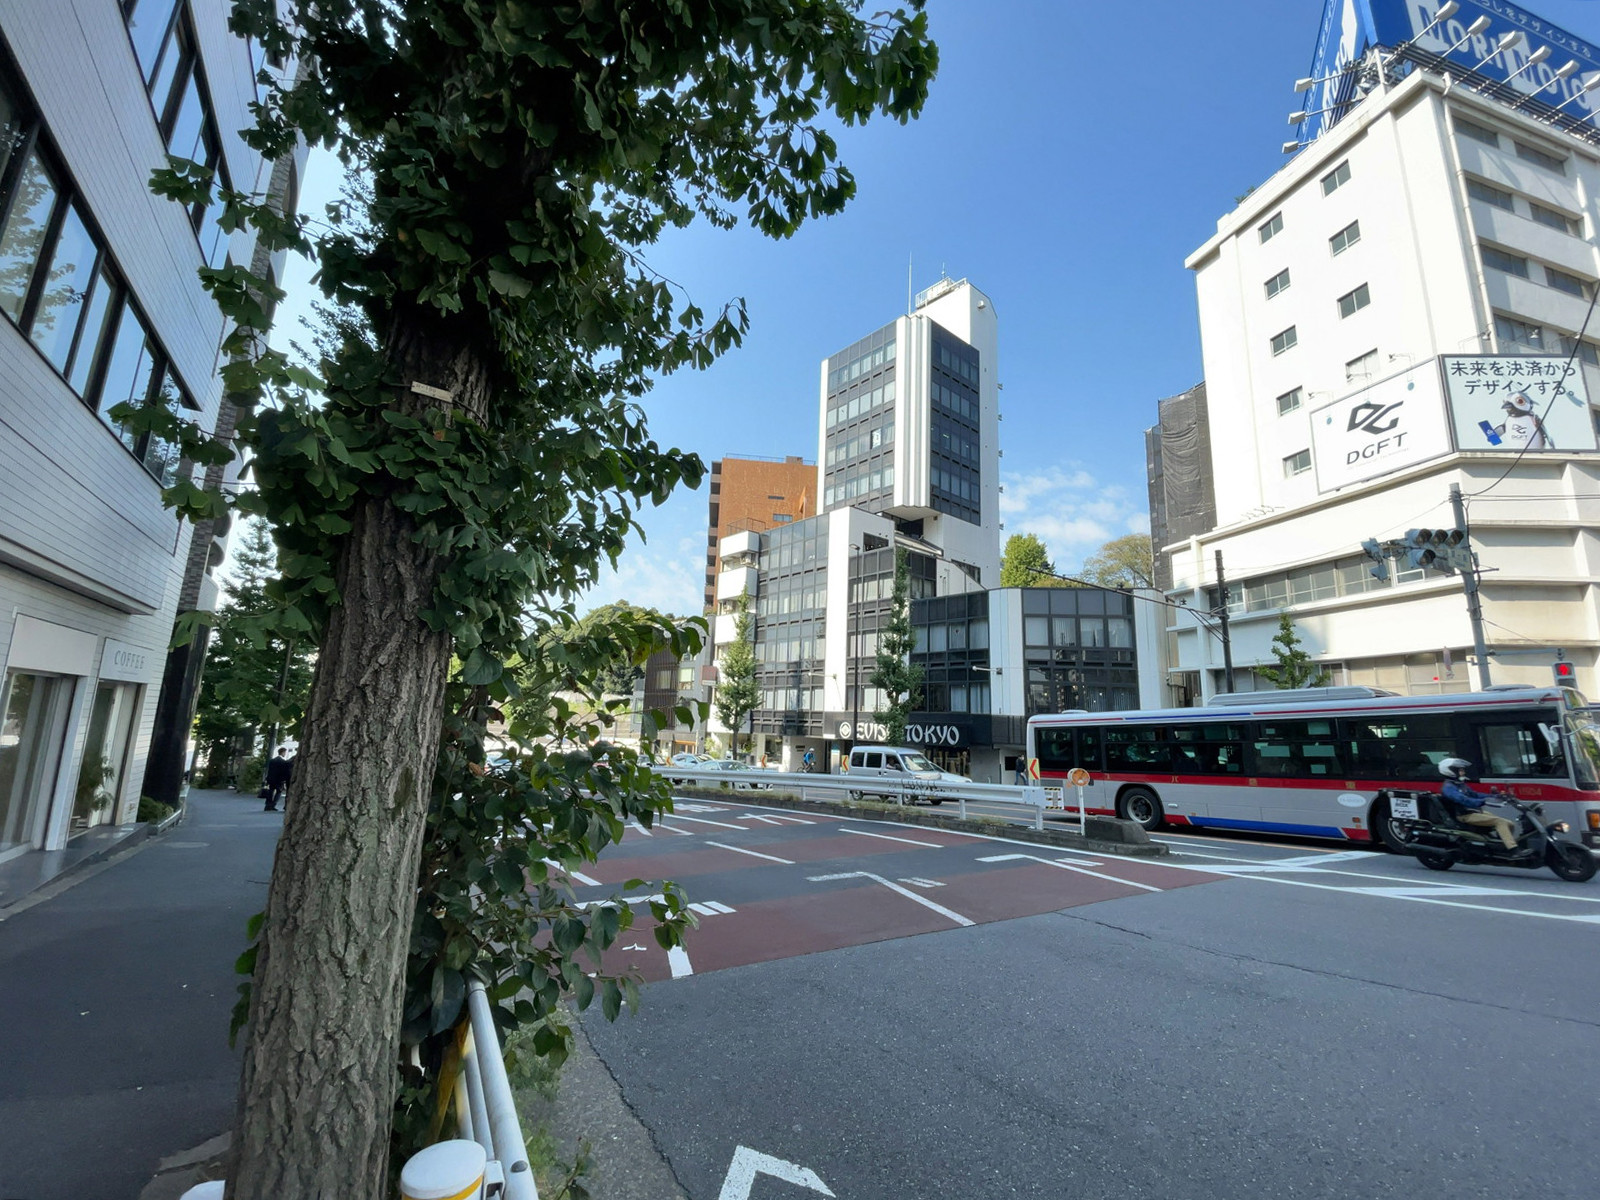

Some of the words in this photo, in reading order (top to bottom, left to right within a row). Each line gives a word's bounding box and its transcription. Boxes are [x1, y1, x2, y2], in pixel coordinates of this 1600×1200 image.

[1451, 360, 1576, 377] 未来を決済から
[1464, 379, 1575, 396] デザインする。
[1346, 431, 1408, 465] DGFT
[114, 650, 146, 670] COFFEE
[856, 722, 891, 741] EVIS
[904, 724, 960, 746] TOKYO
